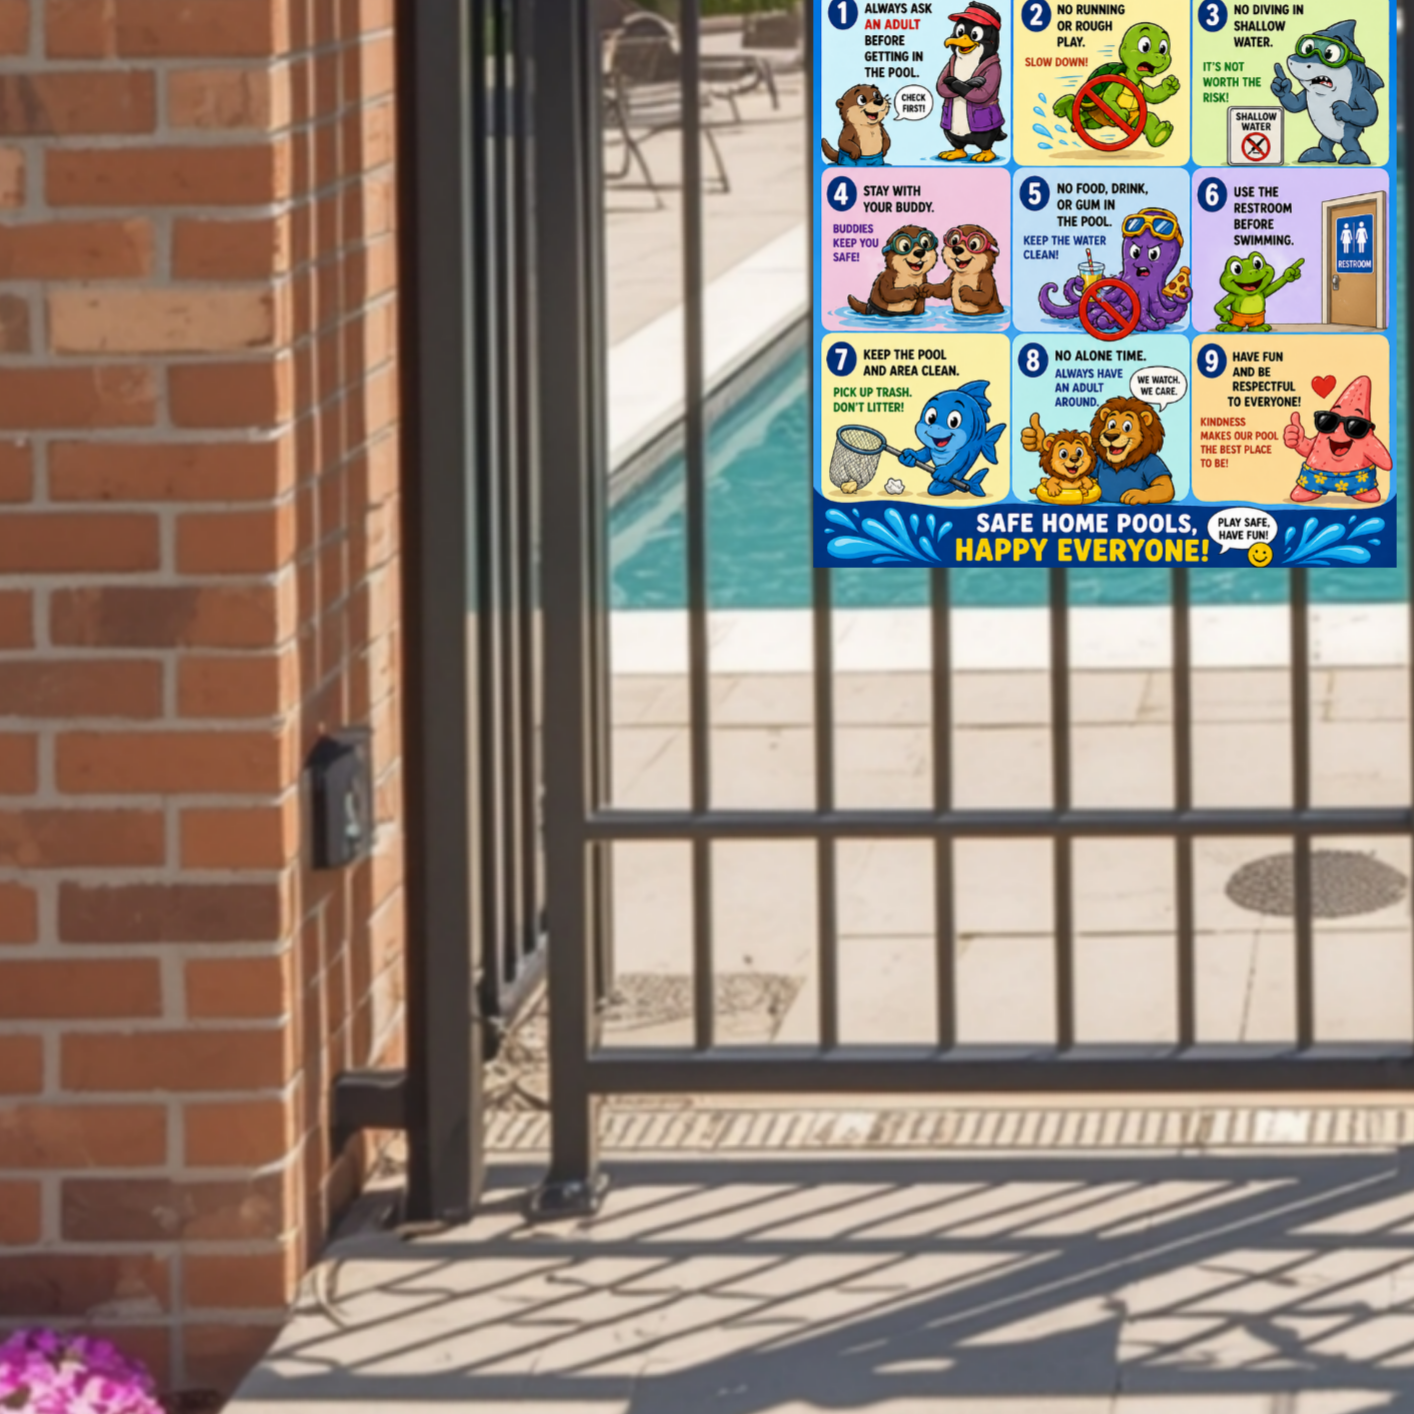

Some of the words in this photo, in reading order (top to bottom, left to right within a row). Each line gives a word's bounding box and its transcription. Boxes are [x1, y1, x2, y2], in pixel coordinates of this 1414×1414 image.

[837, 1, 847, 24] 1
[864, 3, 907, 14] ALWAYS
[911, 3, 932, 14] ASK
[1057, 4, 1073, 15] NO
[1076, 4, 1125, 15] RUNNING
[1234, 4, 1249, 15] NO
[1253, 4, 1289, 15] DIVING
[1293, 4, 1304, 15] IN
[1030, 3, 1043, 26] 2
[1206, 3, 1220, 26] 3
[864, 19, 881, 30] AN
[884, 19, 921, 30] ADULT
[1057, 21, 1072, 31] OR
[1076, 21, 1113, 31] ROUGH
[1234, 21, 1286, 31] SHALLOW
[865, 35, 905, 46] BEFORE
[1057, 37, 1085, 47] PLAY.
[1234, 37, 1273, 47] WATER.
[864, 51, 909, 62] GETTING
[912, 51, 923, 62] IN
[1025, 57, 1052, 67] SLOW
[1055, 57, 1088, 67] DOWN!
[1203, 62, 1221, 72] IT'S
[1224, 62, 1244, 72] NOT
[864, 67, 885, 78] THE
[888, 67, 919, 78] POOL.
[1203, 77, 1239, 87] WORTH
[1242, 77, 1261, 87] THE
[901, 94, 926, 102] CHECK
[1203, 93, 1229, 103] RISK!
[902, 104, 926, 113] FIRST!
[1236, 113, 1277, 121] SHALLOW
[1242, 123, 1271, 131] WATER
[834, 182, 848, 205] 4
[863, 185, 889, 196] STAY
[893, 186, 921, 196] WITH
[1028, 182, 1041, 205] 5
[1057, 183, 1073, 194] NO
[1076, 183, 1108, 195] FOOD,
[1112, 183, 1148, 195] DRINK,
[1234, 186, 1255, 197] USE
[1258, 186, 1279, 197] THE
[1205, 183, 1219, 206] 6
[863, 202, 892, 213] YOUR
[896, 202, 935, 213] BUDDY.
[1057, 199, 1072, 210] OR
[1076, 199, 1100, 210] GUM
[1104, 199, 1115, 210] IN
[1234, 203, 1292, 214] RESTROOM
[1057, 216, 1078, 227] THE
[1081, 216, 1112, 227] POOL.
[1234, 219, 1274, 229] BEFORE
[833, 224, 874, 234] BUDDIES
[833, 238, 857, 248] KEEP
[860, 238, 879, 248] YOU
[1023, 236, 1048, 245] KEEP
[1051, 236, 1070, 245] THE
[1073, 236, 1106, 245] WATER
[1234, 235, 1294, 246] SWIMMING.
[833, 252, 860, 262] SAFE!
[1023, 250, 1059, 259] CLEAN!
[1338, 260, 1371, 268] RESTROOM
[835, 348, 848, 370] 7
[864, 349, 891, 360] KEEP
[894, 349, 915, 360] THE
[918, 349, 947, 360] POOL
[1055, 350, 1071, 361] NO
[1075, 350, 1112, 361] ALONE
[1116, 350, 1146, 361] TIME.
[1233, 352, 1260, 362] HAVE
[1263, 352, 1283, 362] FUN
[1026, 349, 1040, 372] 8
[1205, 350, 1219, 372] 9
[863, 365, 886, 376] AND
[890, 365, 918, 376] AREA
[922, 365, 959, 376] CLEAN.
[1055, 369, 1094, 378] ALWAYS
[1097, 369, 1123, 378] HAVE
[1233, 367, 1255, 377] AND
[1258, 367, 1271, 377] BE
[1137, 376, 1149, 384] WE
[1152, 376, 1180, 384] WATCH.
[1055, 383, 1069, 392] AN
[1072, 383, 1104, 392] ADULT
[1140, 387, 1153, 395] WE
[1155, 387, 1178, 395] CARE.
[1233, 381, 1296, 392] RESPECTFUL
[833, 387, 857, 397] PICK
[860, 387, 873, 397] UP
[876, 387, 912, 397] TRASH.
[833, 402, 864, 412] DON'T
[867, 402, 904, 412] LITTER!
[1055, 397, 1099, 407] AROUND.
[1228, 397, 1241, 407] TO
[1245, 397, 1301, 407] EVERYONE!
[1200, 418, 1246, 426] KINDNESS
[1200, 431, 1231, 440] MAKES
[1234, 431, 1253, 440] OUR
[1255, 431, 1279, 440] POOL
[1200, 445, 1217, 454] THE
[1220, 445, 1241, 454] BEST
[1244, 445, 1272, 454] PLACE
[1200, 459, 1212, 468] TO
[1215, 459, 1228, 468] BE!
[977, 513, 1033, 533] SAFE
[1042, 513, 1108, 533] HOME
[1118, 513, 1197, 536] POOLS,
[1218, 518, 1241, 527] PLAY
[1244, 518, 1270, 528] SAFE,
[1219, 531, 1244, 540] HAVE
[1247, 531, 1269, 540] FUN!
[956, 538, 1048, 562] HAPPY
[1058, 538, 1209, 562] EVERYONE!
